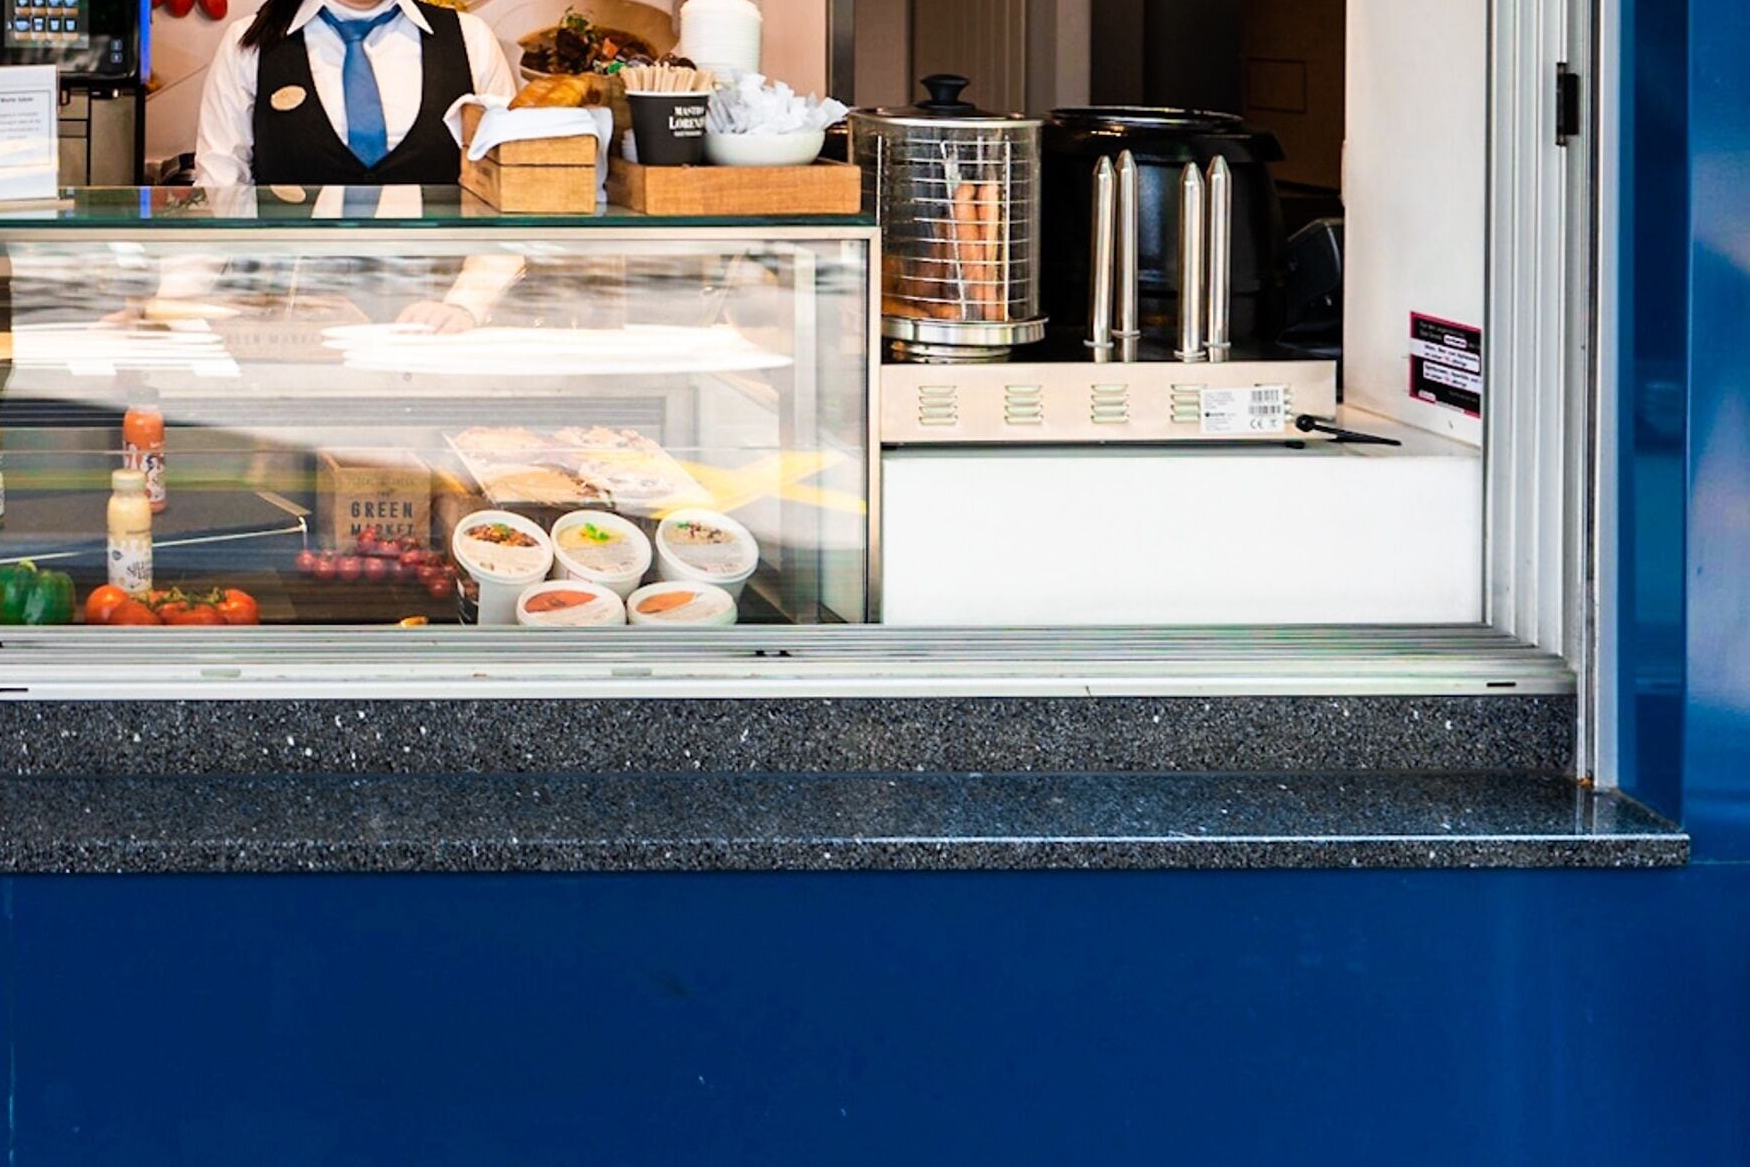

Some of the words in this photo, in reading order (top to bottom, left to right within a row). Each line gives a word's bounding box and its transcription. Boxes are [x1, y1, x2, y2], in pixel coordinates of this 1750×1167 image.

[669, 116, 706, 130] LOREN
[351, 501, 413, 519] GREEN
[351, 523, 414, 539] MRKET
